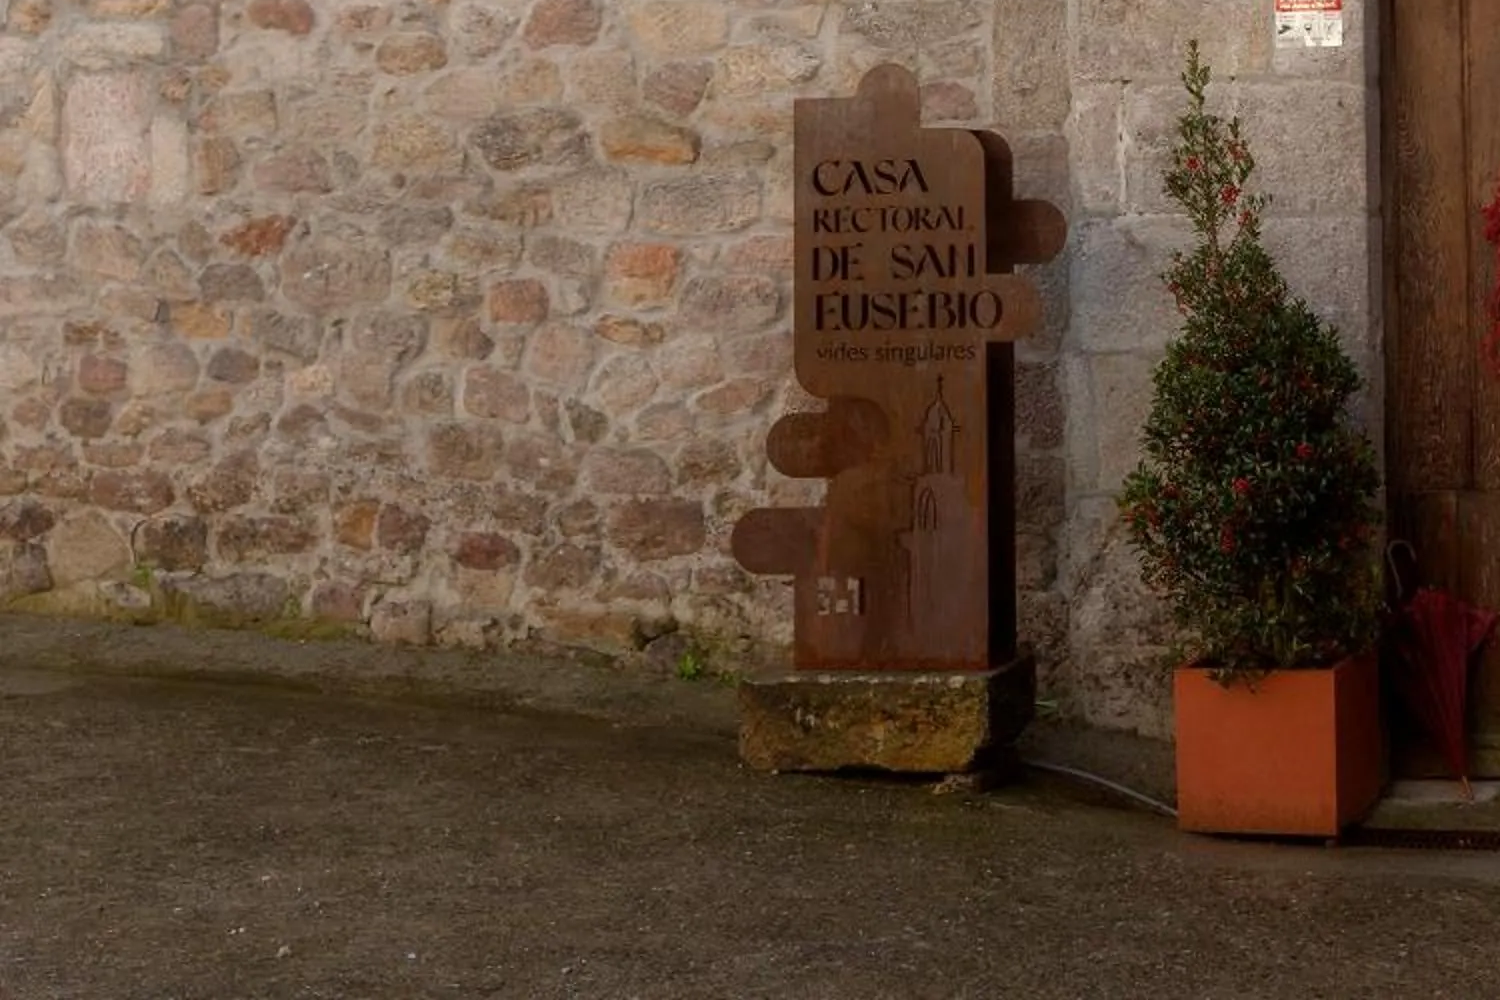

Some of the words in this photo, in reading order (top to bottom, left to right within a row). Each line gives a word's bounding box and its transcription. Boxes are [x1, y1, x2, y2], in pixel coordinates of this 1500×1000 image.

[811, 158, 929, 197] CASA
[813, 205, 976, 233] RECTORAL
[811, 242, 865, 281] DE
[814, 287, 1003, 331] EUSEBIO
[874, 339, 977, 366] singulares
